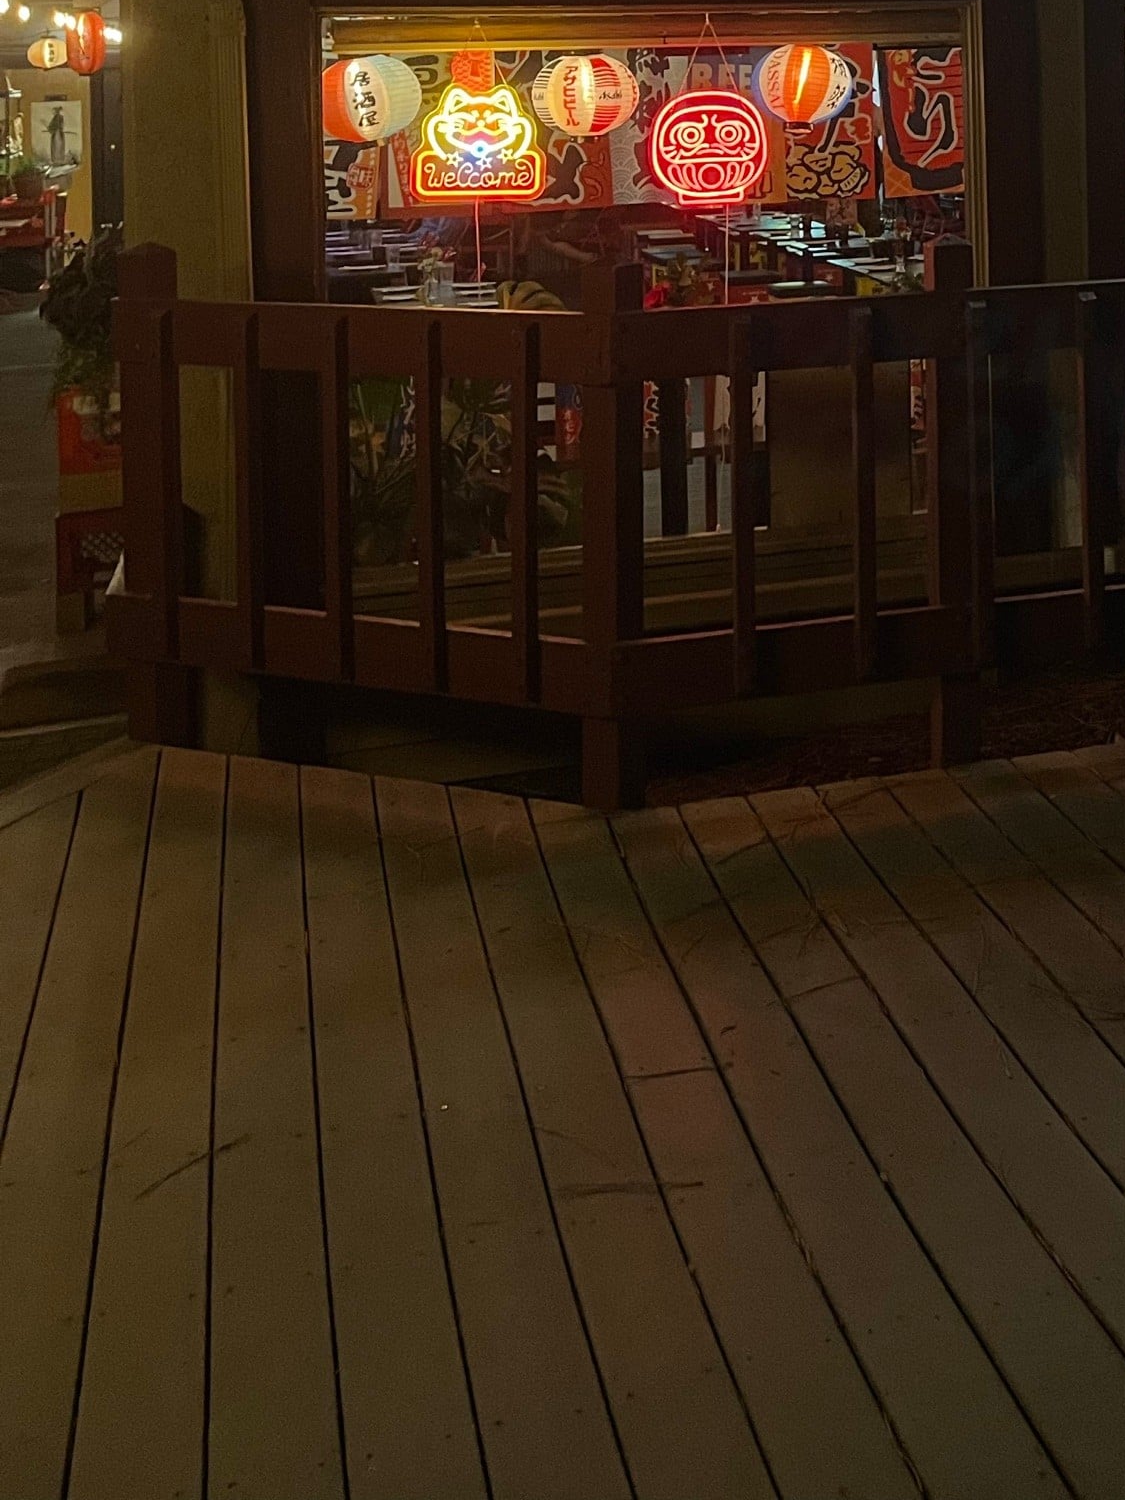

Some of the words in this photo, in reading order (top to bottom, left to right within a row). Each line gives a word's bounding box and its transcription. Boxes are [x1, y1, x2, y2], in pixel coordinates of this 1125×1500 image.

[350, 71, 380, 128] 居酒屋
[767, 49, 788, 109] DASSAI
